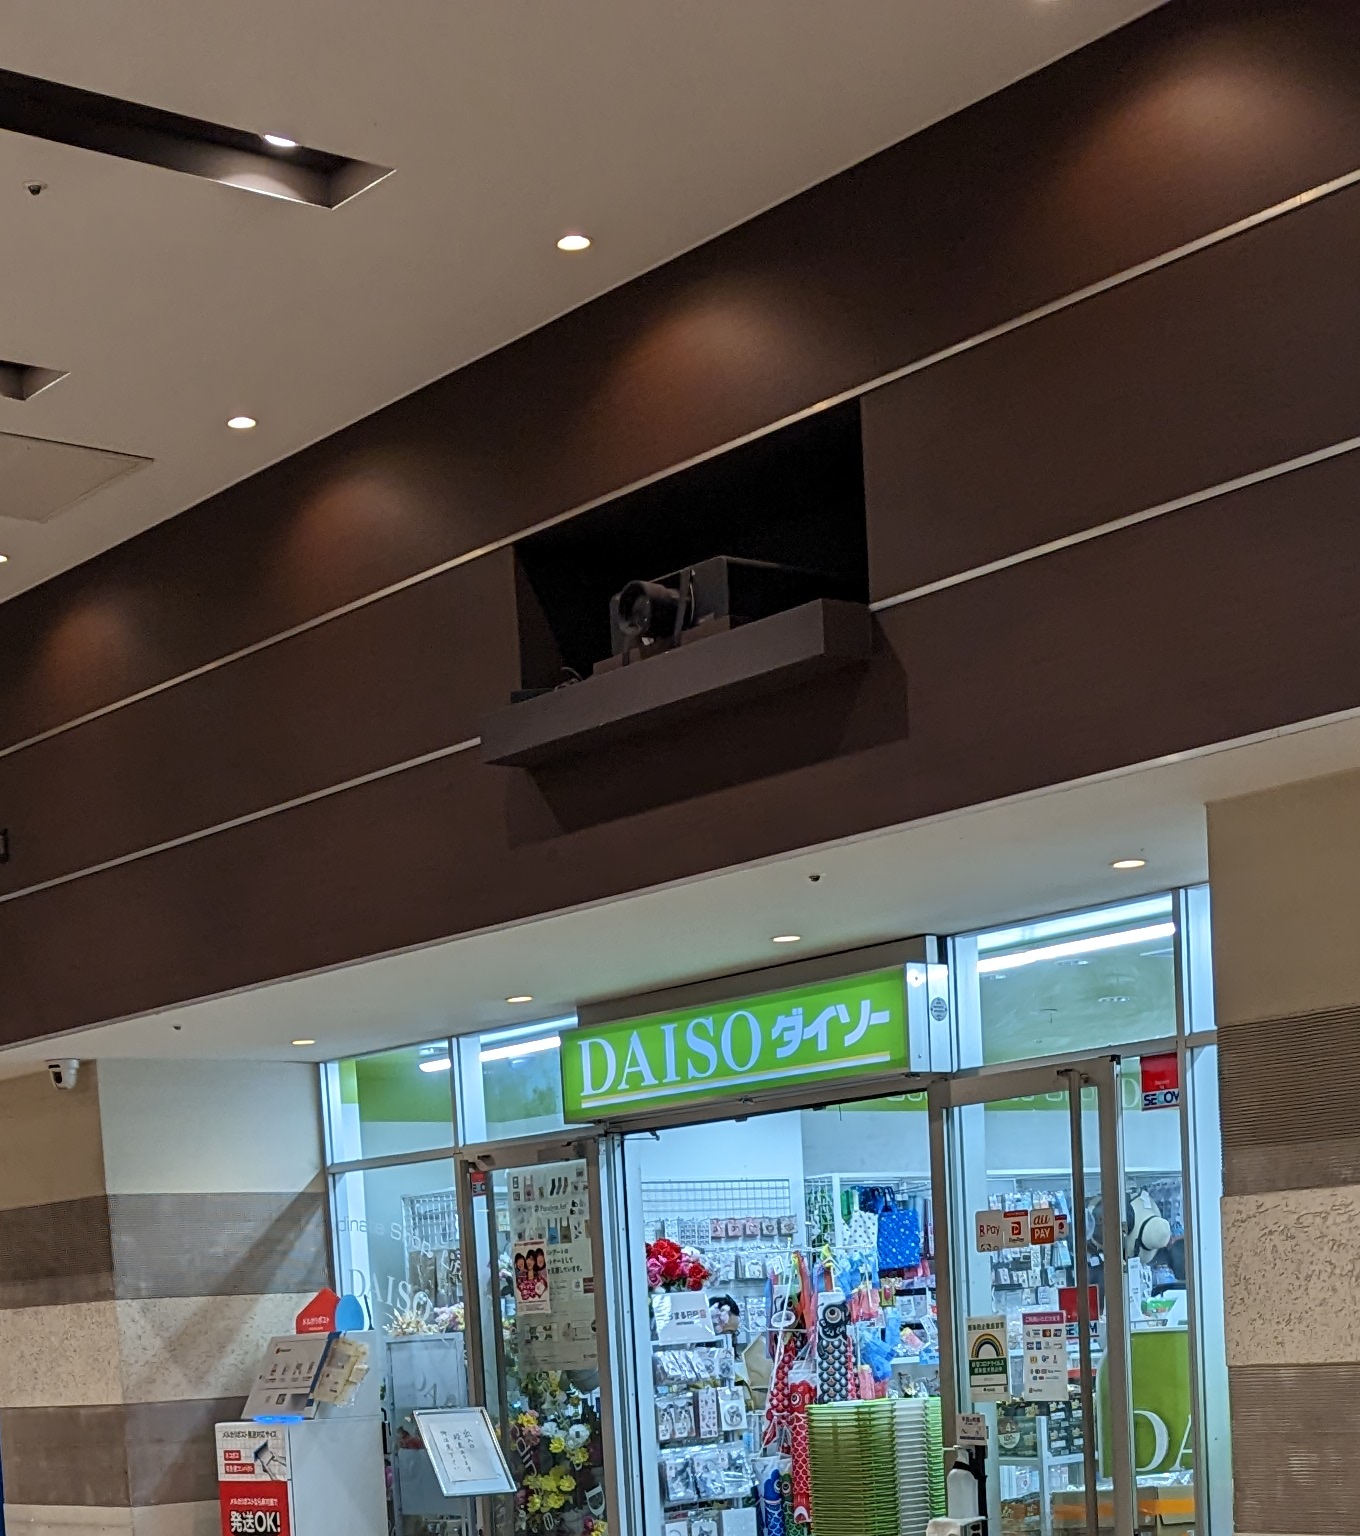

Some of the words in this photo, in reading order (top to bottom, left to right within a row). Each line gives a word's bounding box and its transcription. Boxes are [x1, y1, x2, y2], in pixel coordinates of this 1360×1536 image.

[577, 1010, 762, 1096] DAISO
[771, 999, 891, 1059] ダイソー
[1033, 1215, 1050, 1226] au
[1034, 1227, 1050, 1239] PAY
[229, 1510, 281, 1533] 発送OK!
